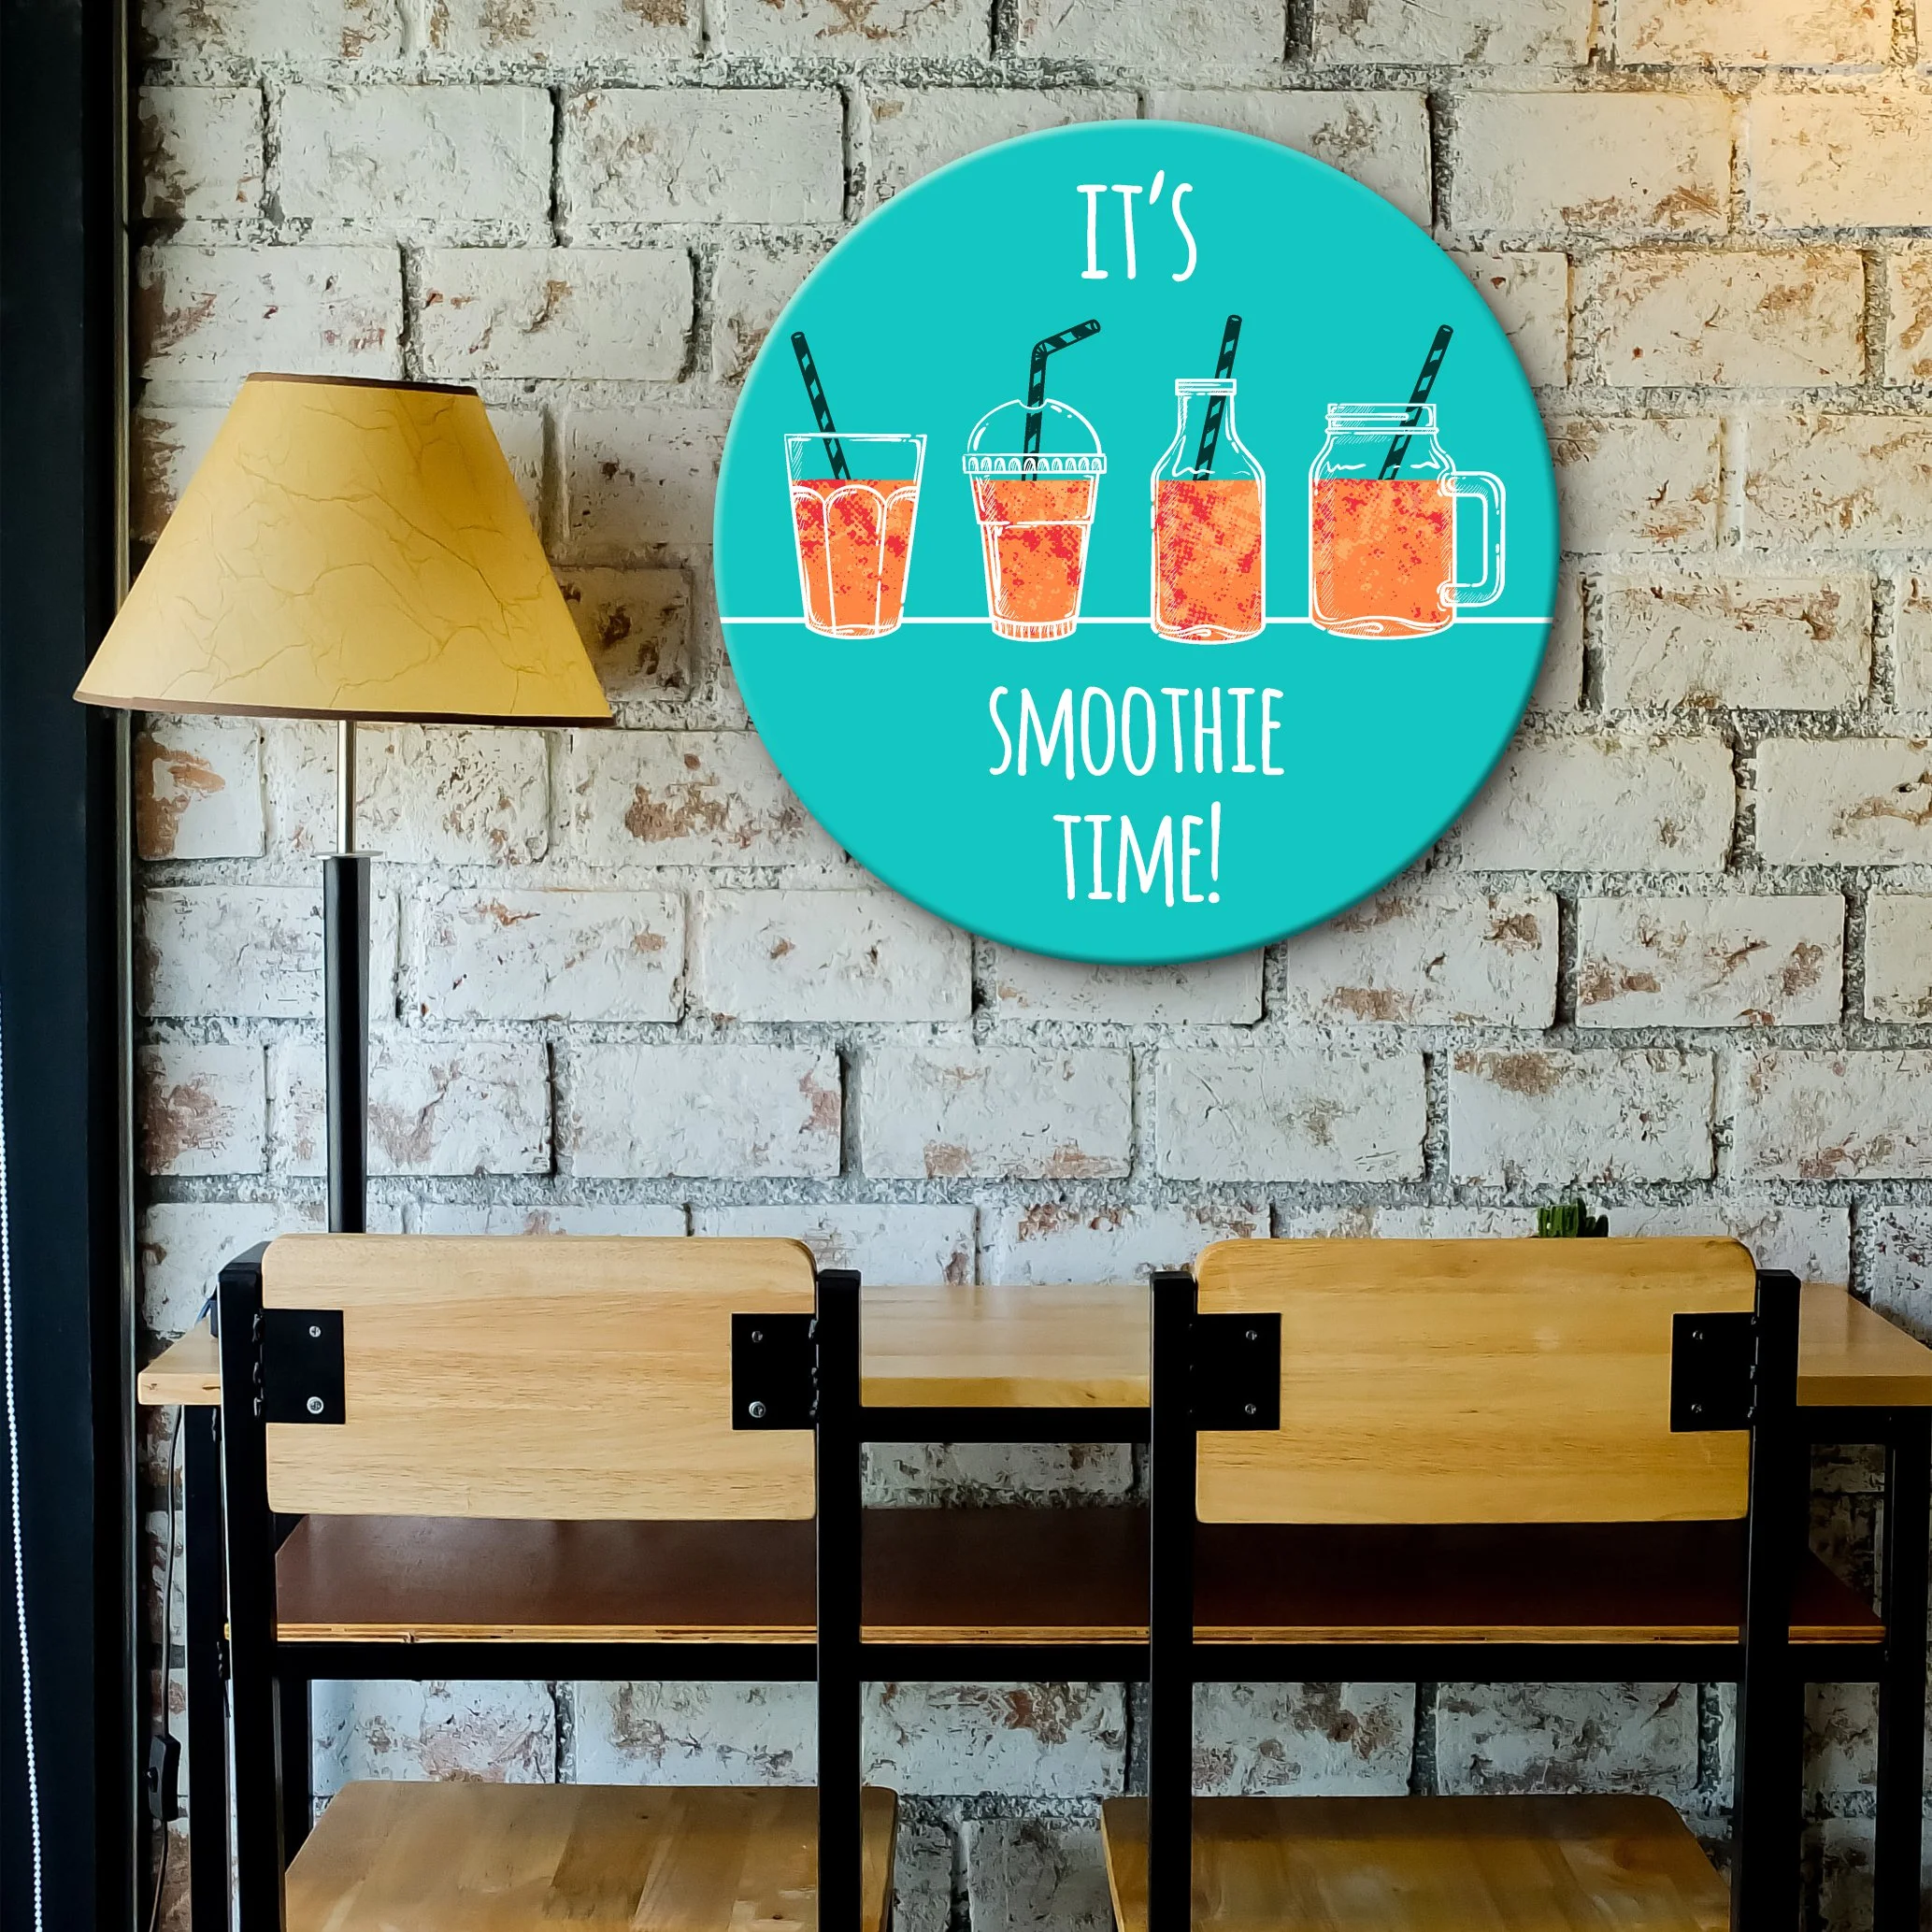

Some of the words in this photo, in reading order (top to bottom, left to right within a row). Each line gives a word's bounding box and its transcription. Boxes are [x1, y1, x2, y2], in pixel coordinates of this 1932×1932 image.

[1076, 170, 1197, 282] IT'S
[989, 686, 1285, 780] SMOOTHIE
[1052, 801, 1222, 908] TIME!
